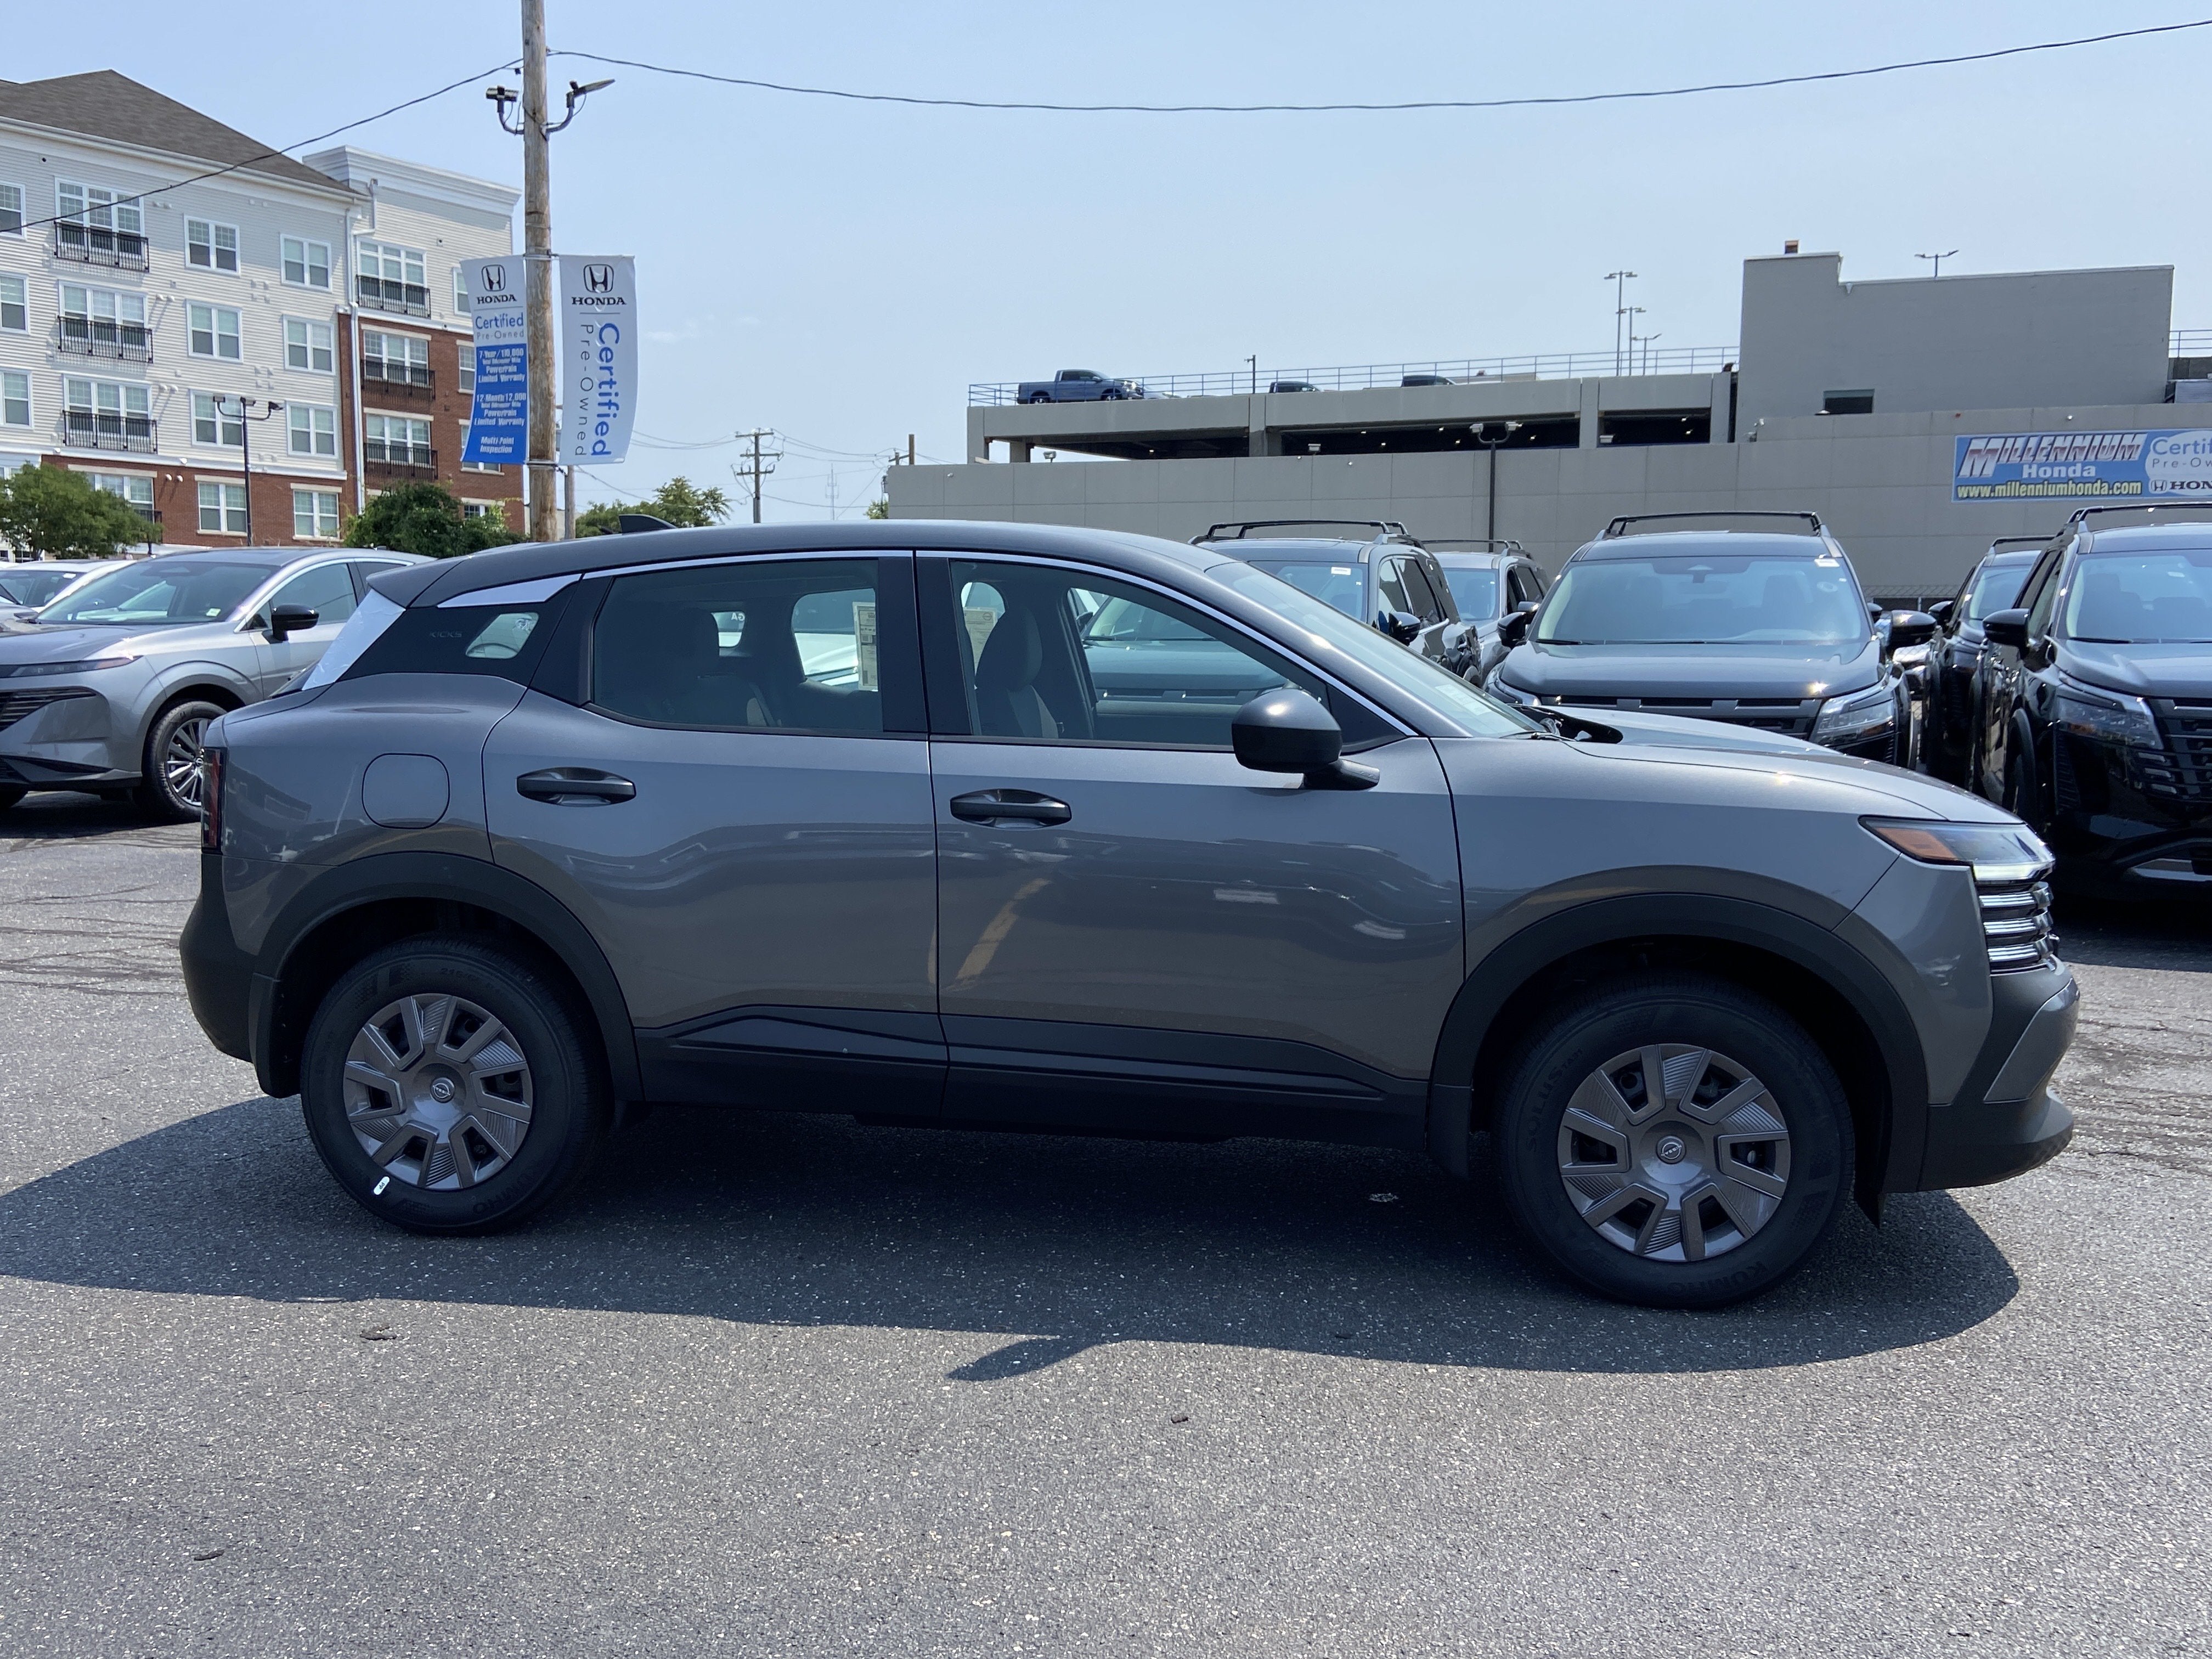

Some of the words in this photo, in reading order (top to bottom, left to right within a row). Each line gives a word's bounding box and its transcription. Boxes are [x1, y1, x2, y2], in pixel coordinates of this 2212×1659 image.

[477, 294, 517, 304] HONDA
[571, 297, 627, 305] HONDA
[475, 312, 524, 330] Certified
[477, 329, 524, 340] Pre-Owned
[575, 324, 594, 456] Pre-Owned
[591, 323, 620, 456] Certified
[480, 445, 512, 454] Inspection
[1957, 432, 2148, 478] MILLENNIUM
[2022, 463, 2096, 478] Honda
[1957, 479, 2142, 498] www.millenniumhonda.com
